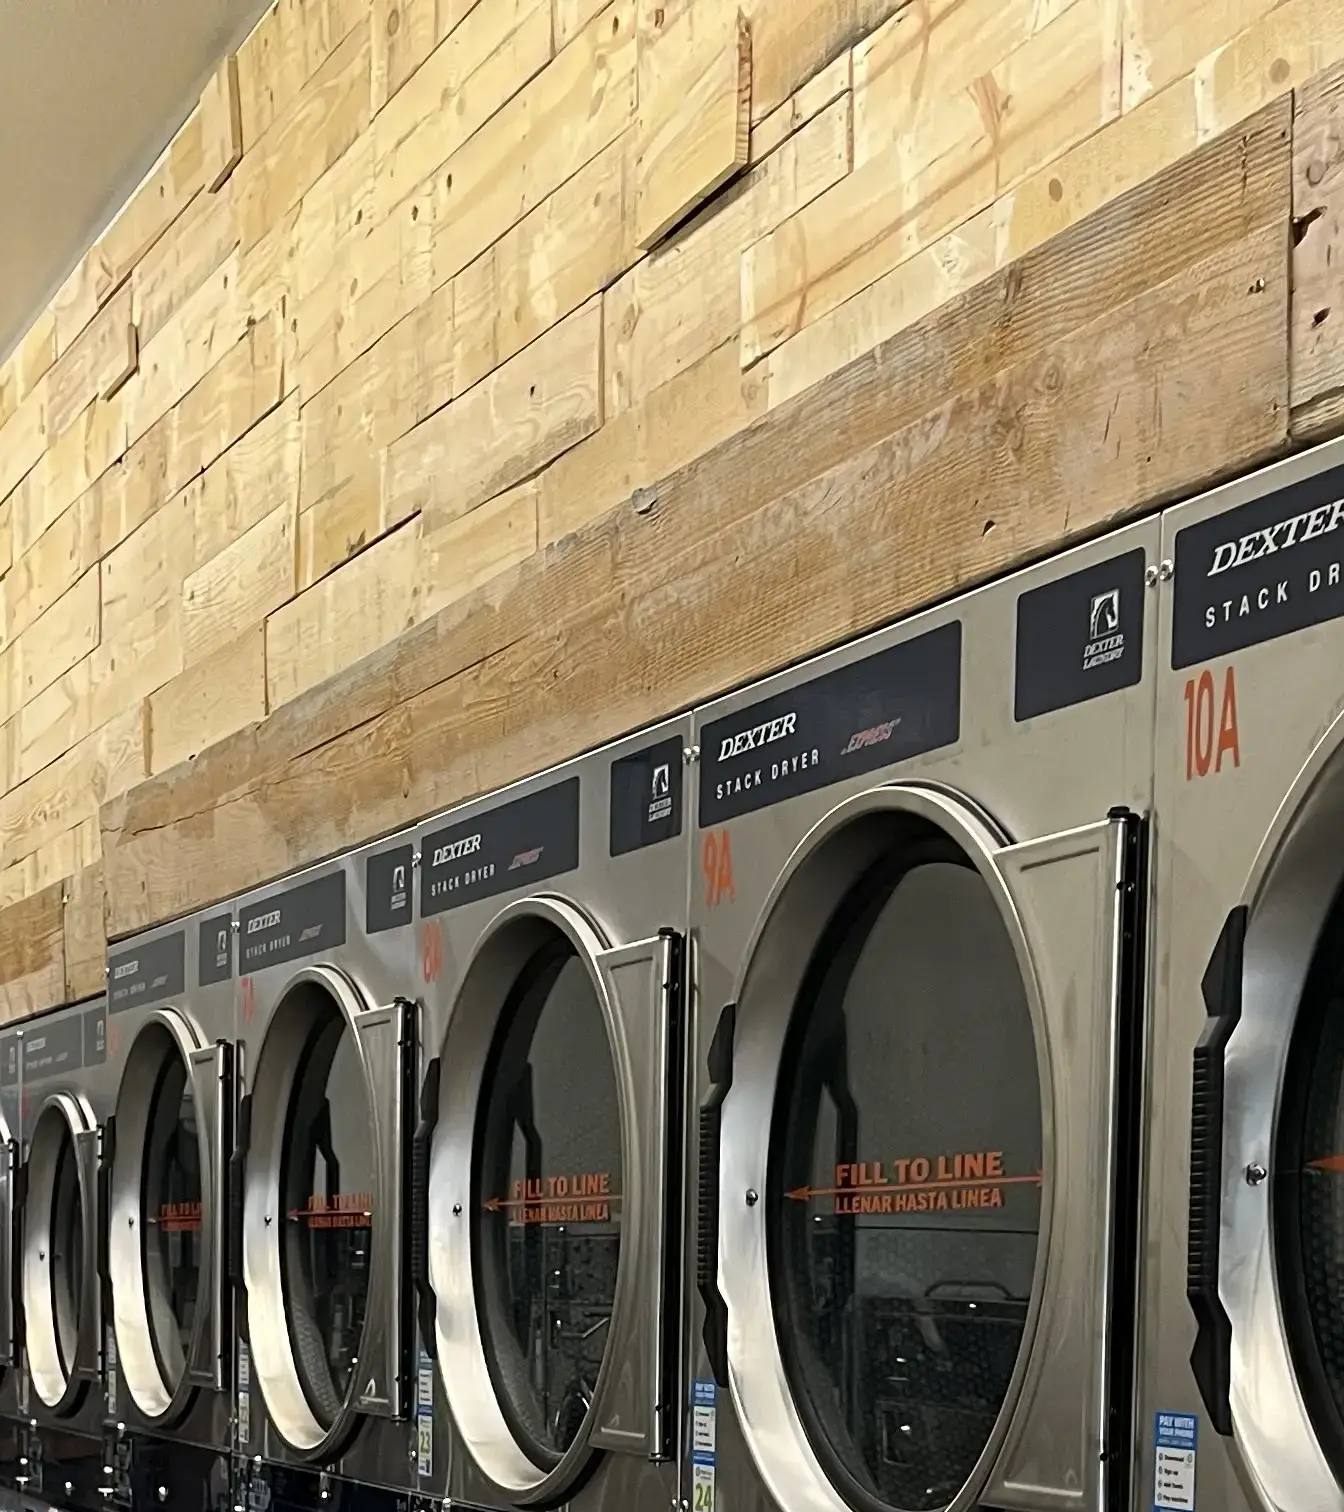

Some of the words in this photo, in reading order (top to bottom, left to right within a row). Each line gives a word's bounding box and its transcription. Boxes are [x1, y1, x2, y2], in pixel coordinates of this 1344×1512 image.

[1205, 581, 1289, 628] STACK
[718, 712, 797, 762] DEXTER
[1184, 666, 1241, 782] 10A
[716, 769, 764, 800] STACK
[771, 748, 820, 780] DRYER
[432, 833, 481, 867] DEXTER
[702, 829, 736, 911] 9A
[431, 876, 460, 897] STACK
[514, 1178, 544, 1199] FILL
[548, 1175, 568, 1197] TO
[572, 1172, 610, 1195] LINE
[836, 1163, 888, 1186] FILL
[894, 1158, 930, 1183] TO
[938, 1151, 1003, 1179] LINE
[836, 1195, 892, 1214] LLENAR
[895, 1191, 947, 1212] HASTA
[952, 1188, 1002, 1208] LINEA
